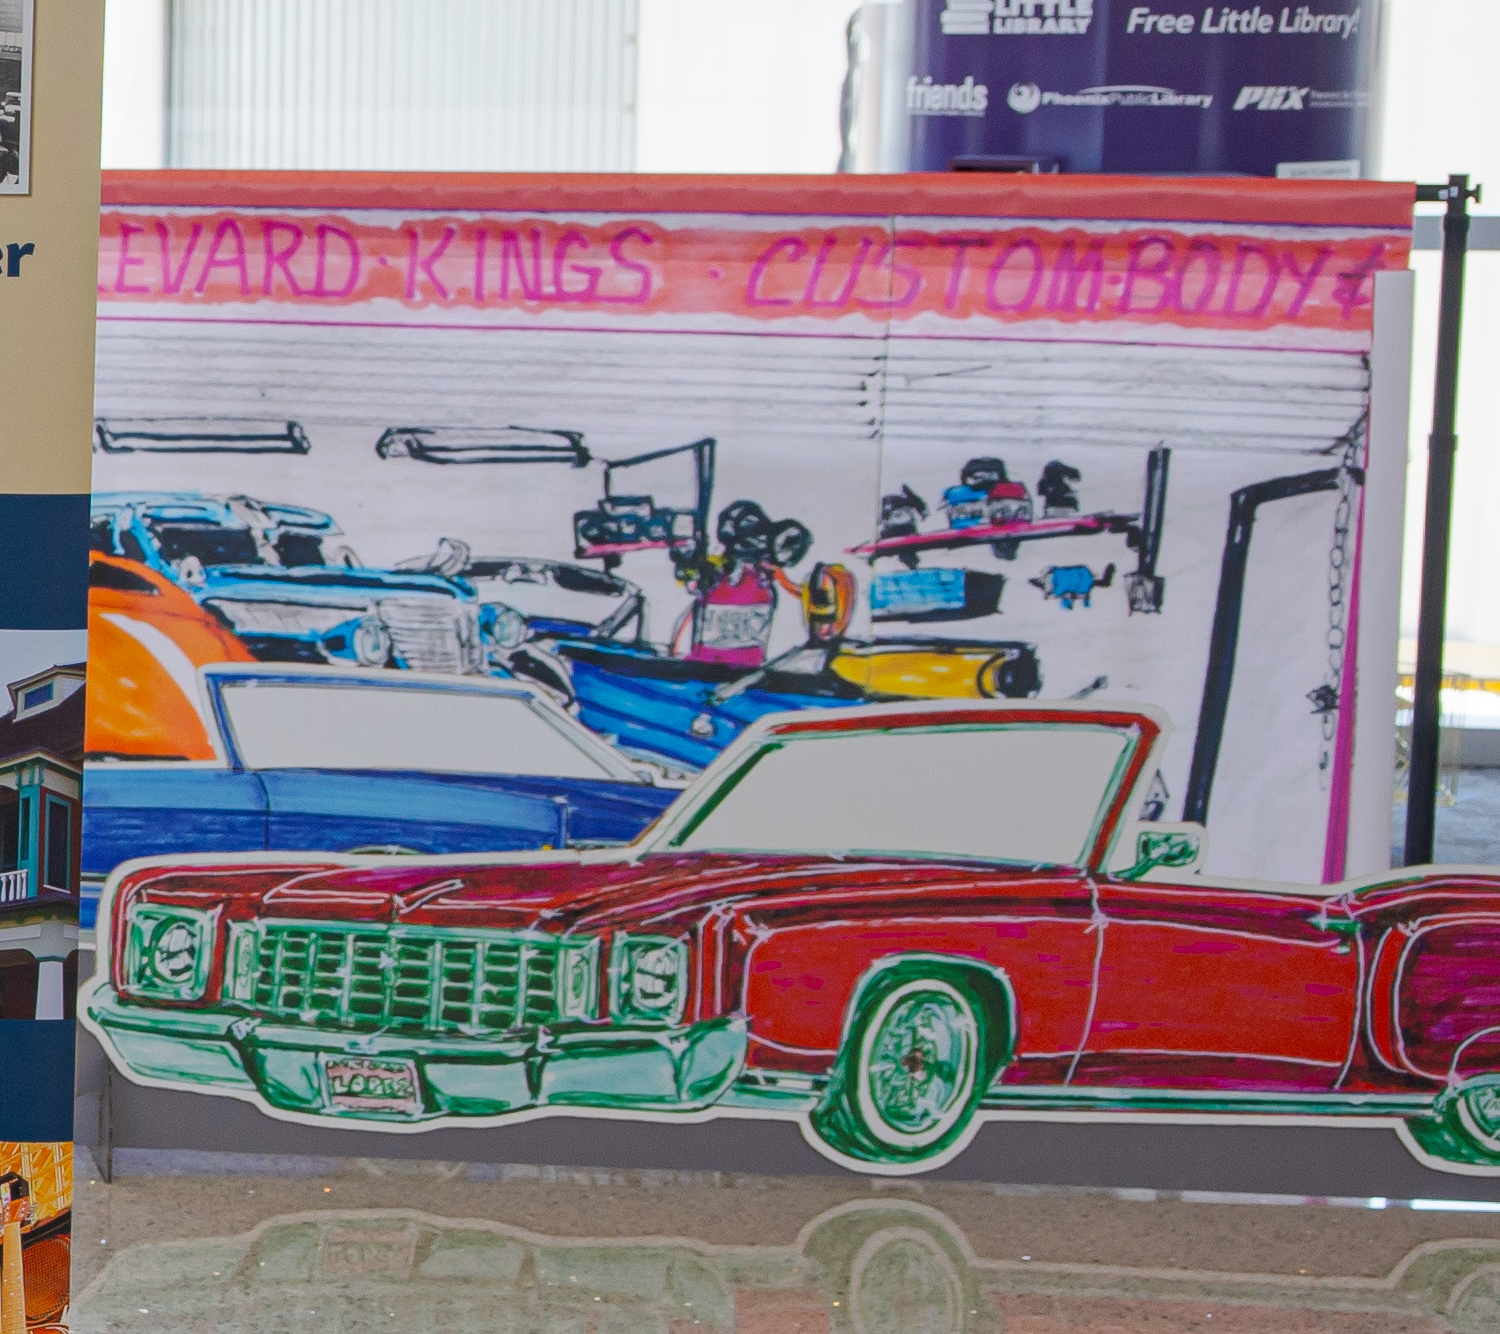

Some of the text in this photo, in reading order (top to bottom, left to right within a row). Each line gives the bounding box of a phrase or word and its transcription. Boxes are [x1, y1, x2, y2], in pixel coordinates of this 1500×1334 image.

[993, 16, 1093, 35] LIBRARY
[1127, 7, 1195, 34] Free
[1201, 6, 1273, 34] Little
[100, 220, 360, 299] EVARD
[401, 226, 653, 308] KINGS
[746, 227, 1108, 312] CUSTOM
[1121, 229, 1329, 317] BODY
